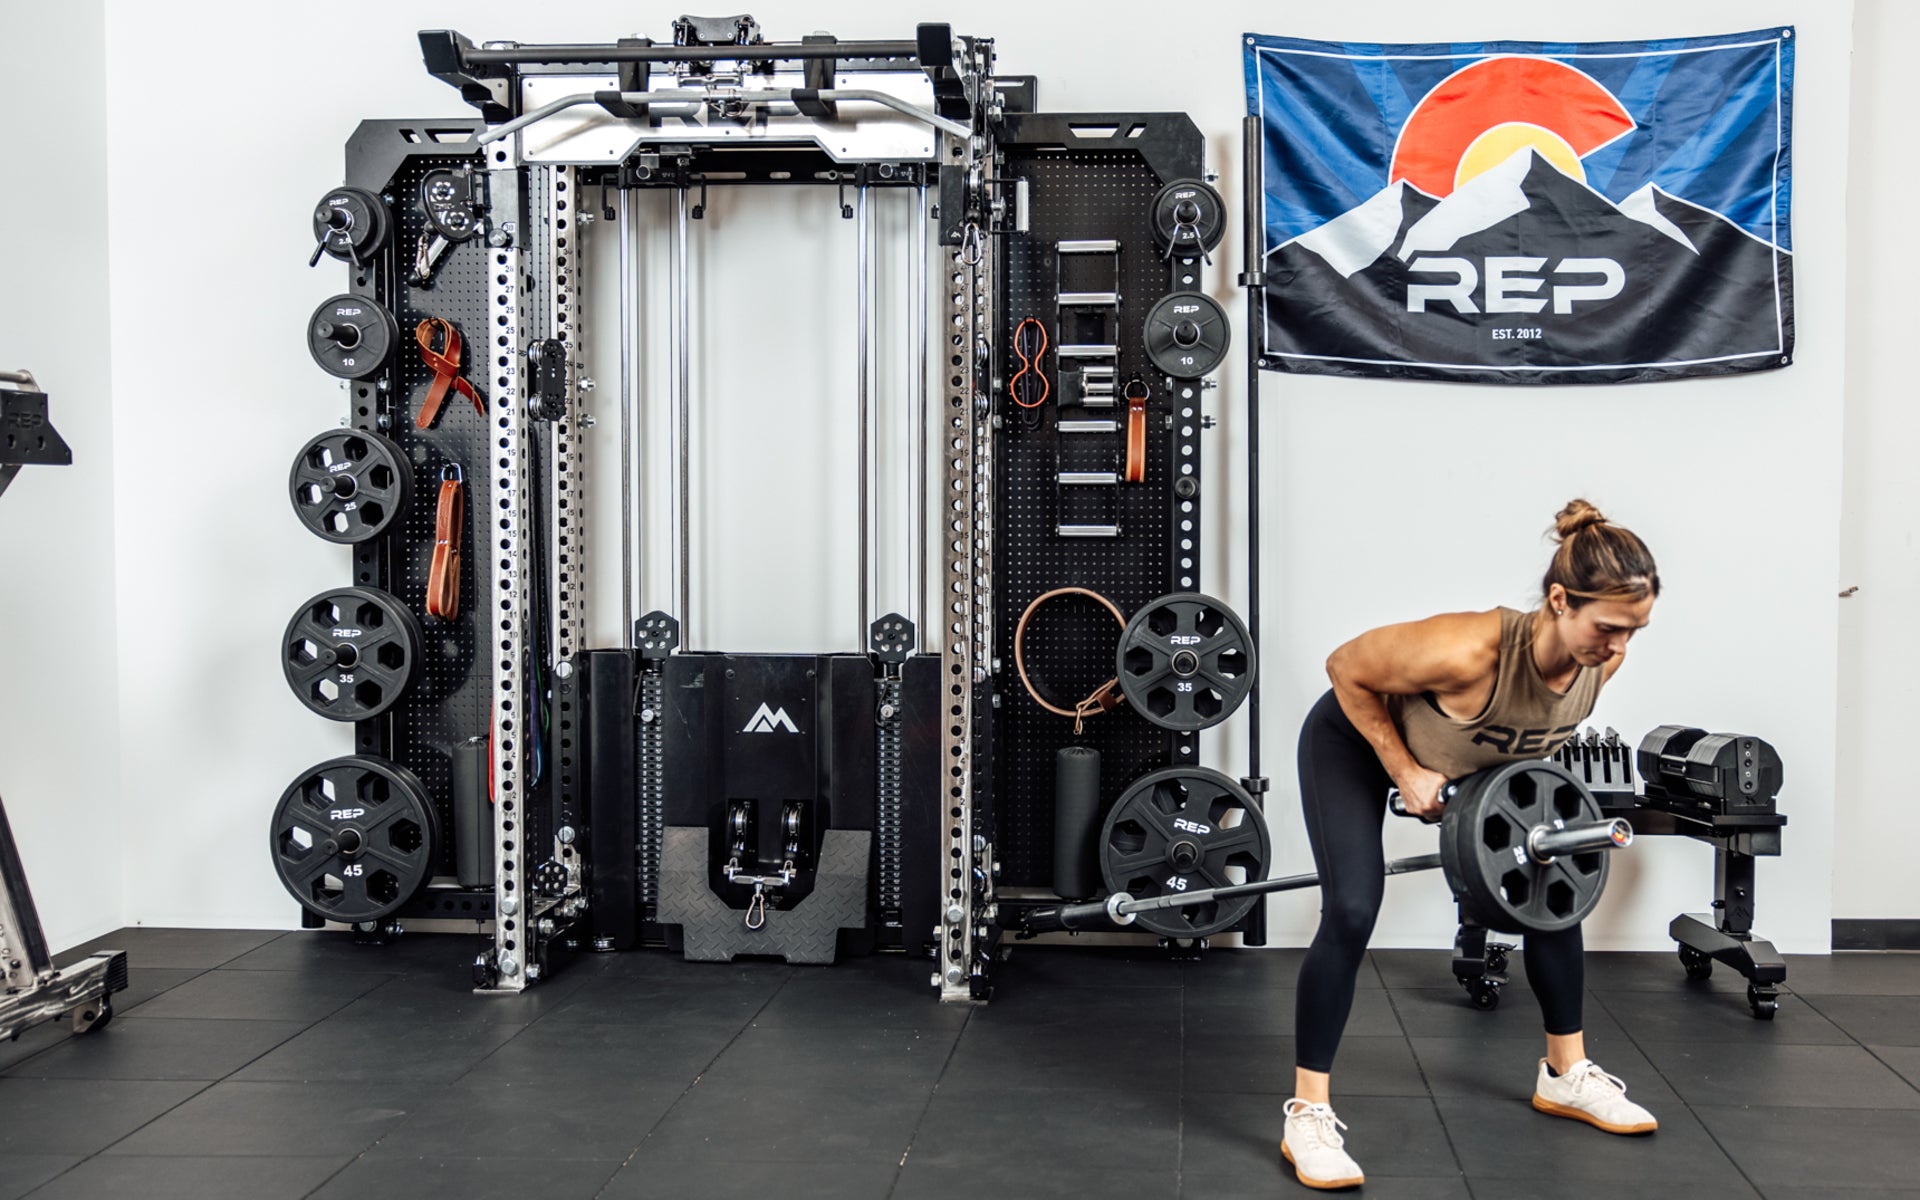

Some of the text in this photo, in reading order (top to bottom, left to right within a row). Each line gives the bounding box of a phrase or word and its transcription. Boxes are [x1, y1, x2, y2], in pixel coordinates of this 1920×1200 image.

[1407, 256, 1626, 314] REP
[1174, 306, 1199, 314] REP
[1492, 328, 1542, 340] EST. 2012
[1180, 356, 1194, 364] 10
[8, 411, 43, 430] REP
[330, 462, 352, 472] REP
[344, 502, 356, 512] 25
[332, 628, 362, 638] REP
[1170, 636, 1200, 645] REP
[340, 674, 354, 683] 35
[1177, 683, 1192, 692] 35
[330, 808, 365, 820] REP
[1174, 818, 1210, 834] REP
[344, 864, 363, 876] 45
[1166, 876, 1188, 890] 45
